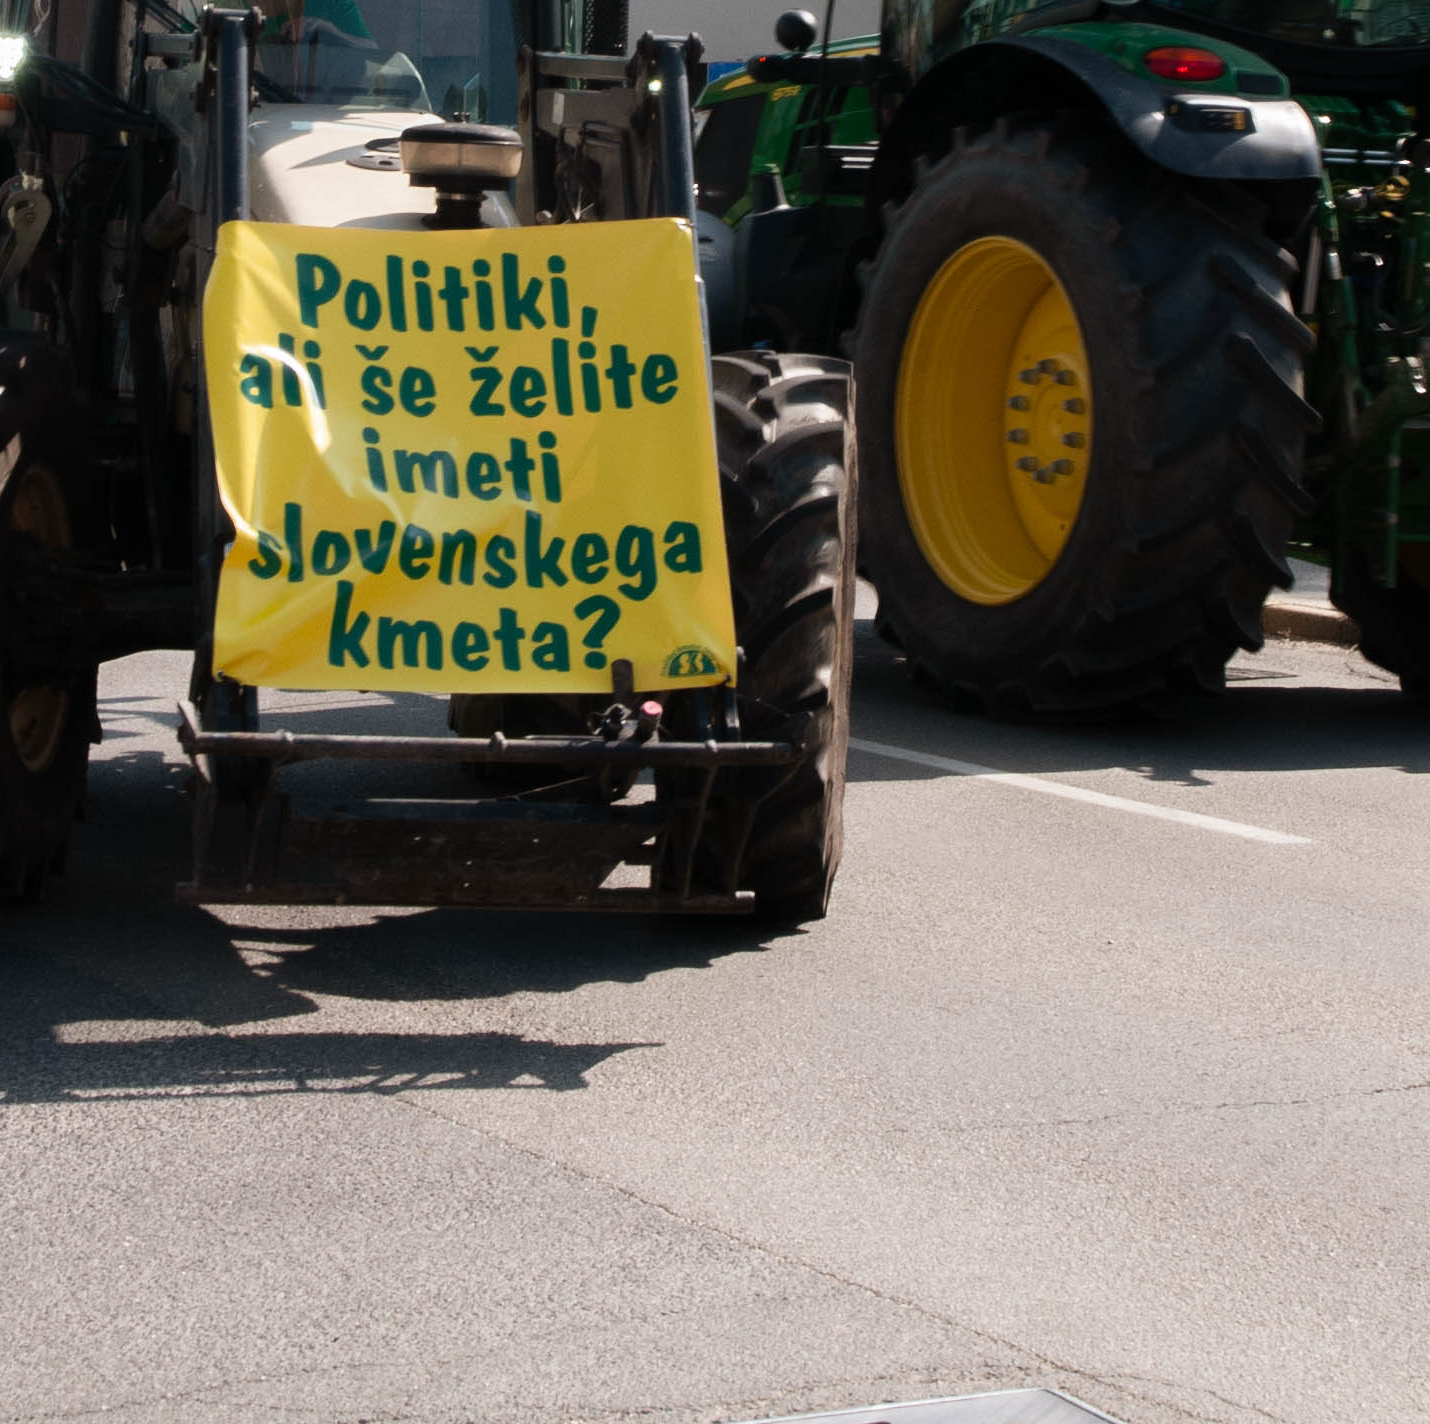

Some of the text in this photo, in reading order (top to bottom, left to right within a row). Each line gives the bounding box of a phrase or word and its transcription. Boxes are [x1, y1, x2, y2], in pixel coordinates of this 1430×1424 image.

[294, 252, 598, 338] Politiki,
[239, 333, 679, 417] ali še želite
[362, 426, 562, 503] imeti
[248, 501, 703, 602] slovenskega
[328, 580, 622, 673] kmeta?
